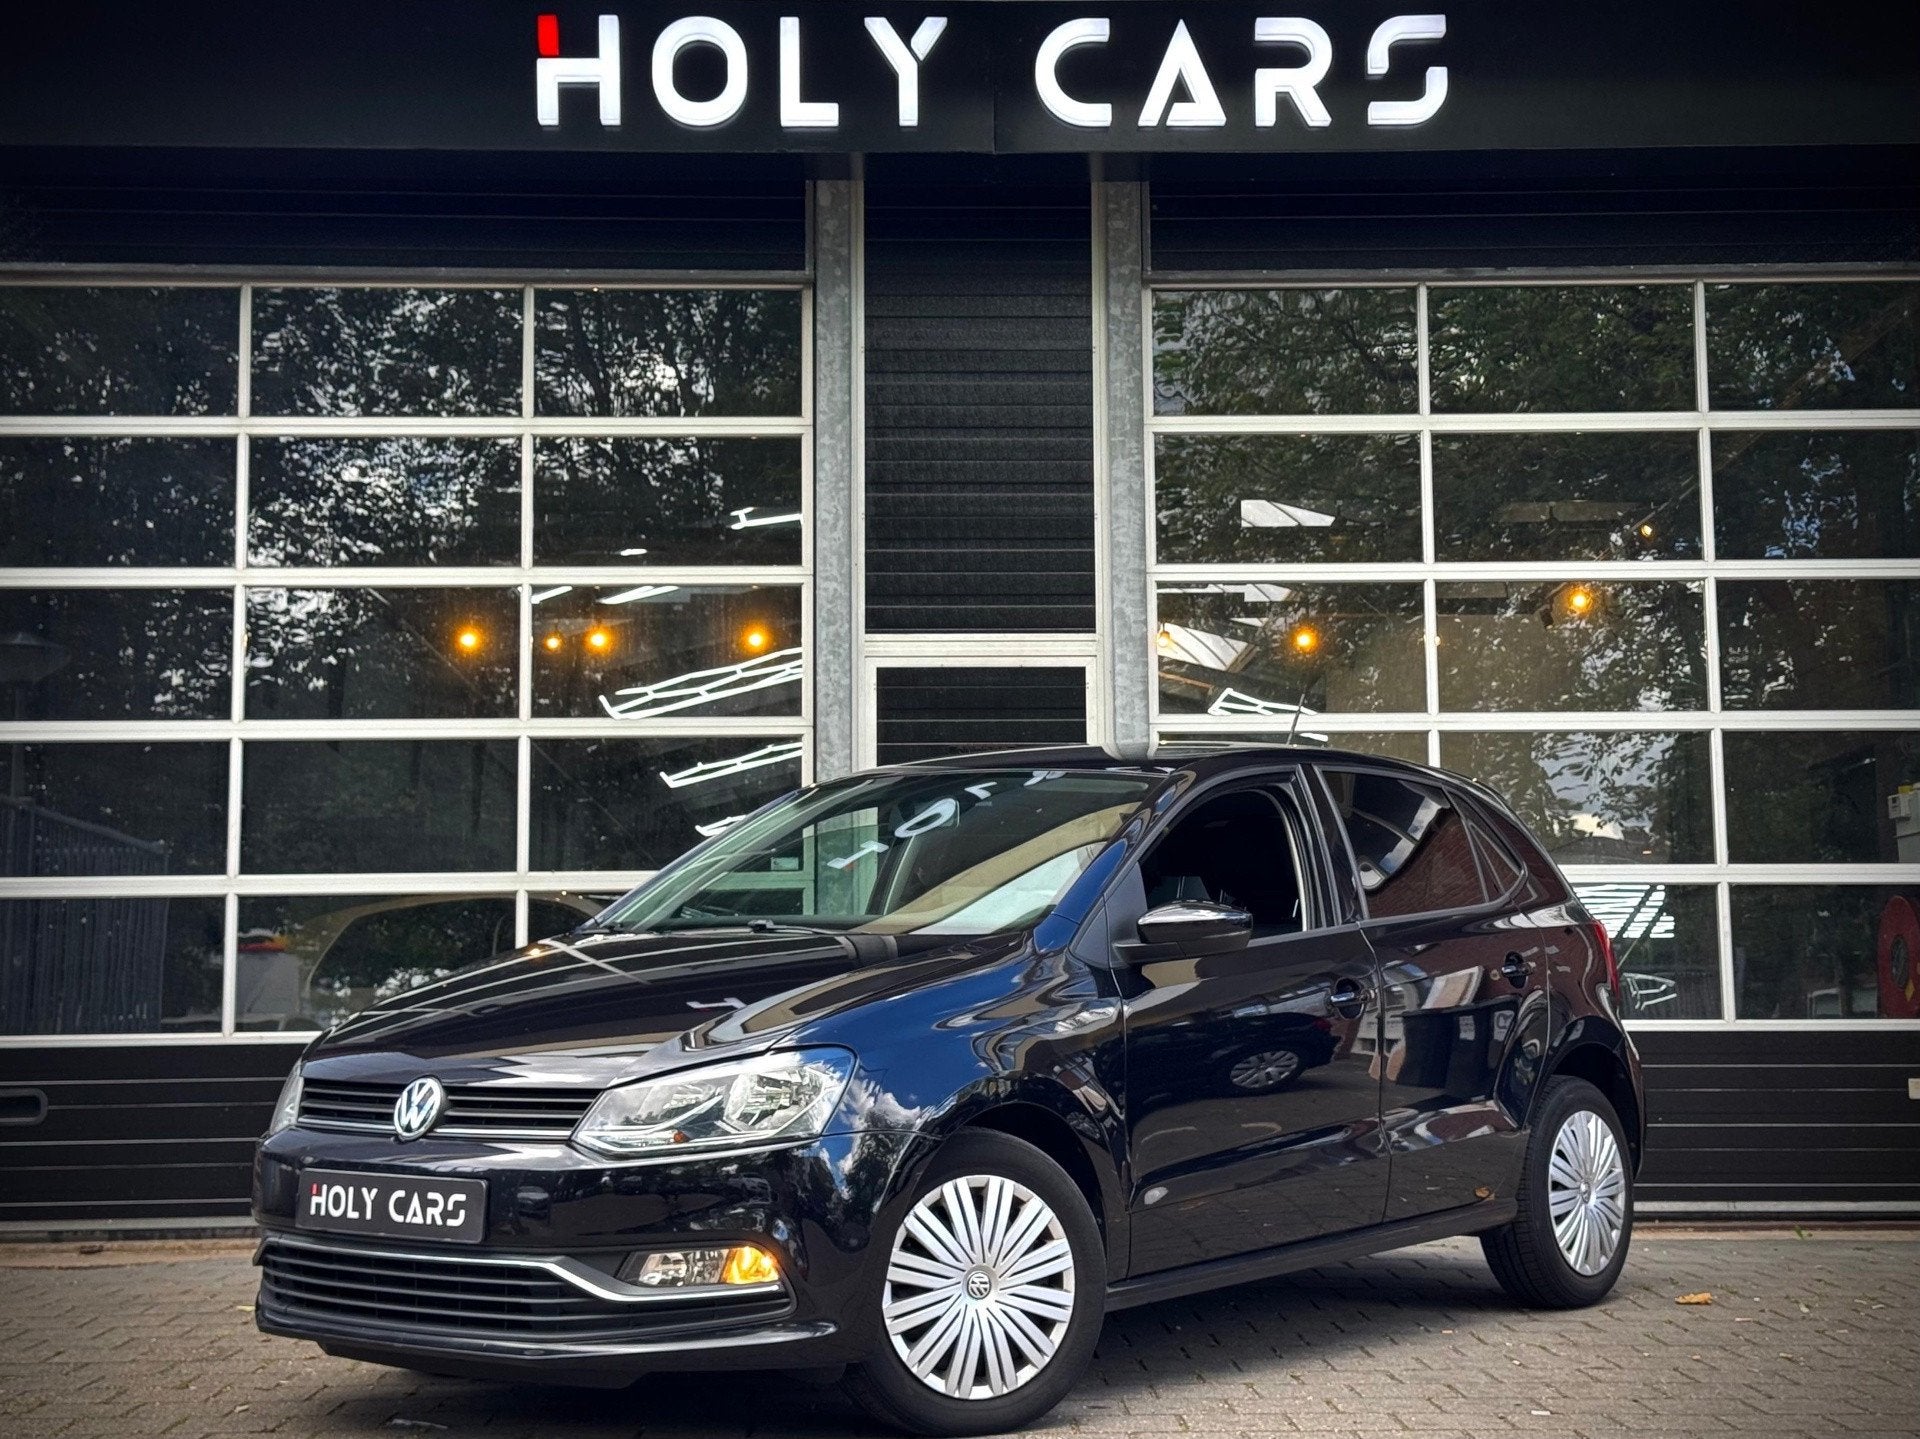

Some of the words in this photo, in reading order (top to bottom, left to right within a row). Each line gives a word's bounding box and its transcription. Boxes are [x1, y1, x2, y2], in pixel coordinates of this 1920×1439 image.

[537, 15, 948, 127] HOLY
[1035, 14, 1449, 127] CARS
[394, 1078, 441, 1137] VW
[310, 1183, 378, 1221] HOLY
[388, 1189, 467, 1227] CARS
